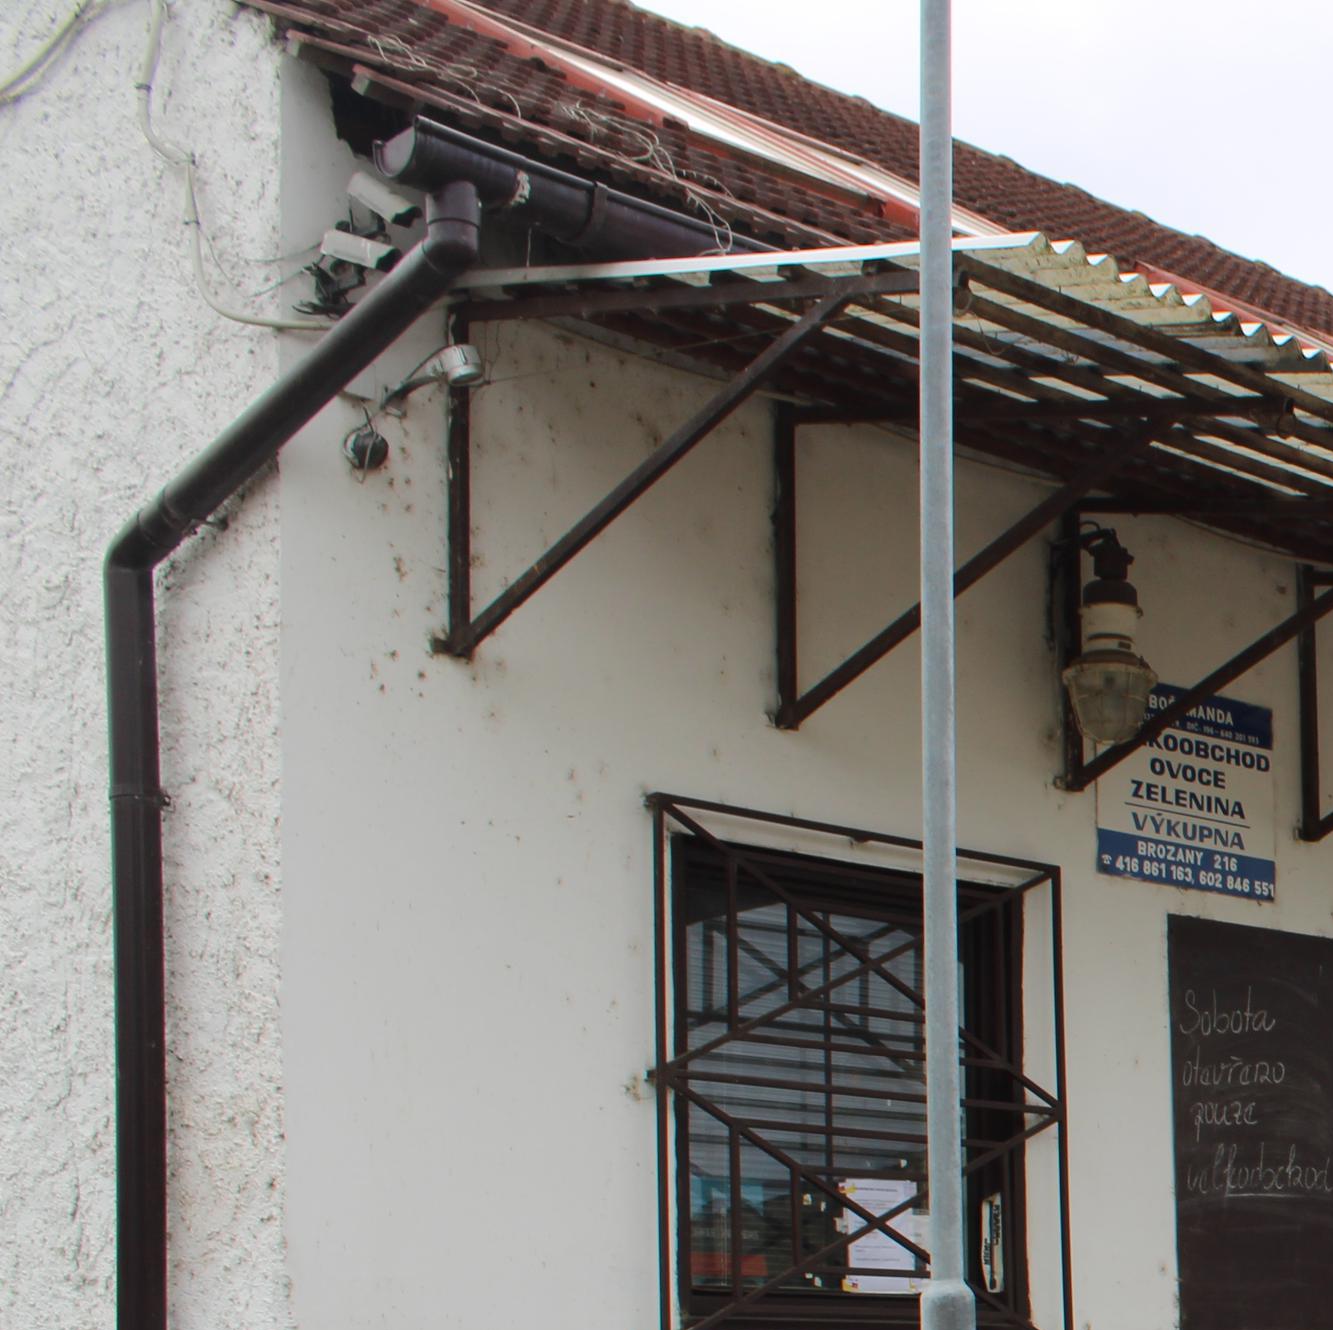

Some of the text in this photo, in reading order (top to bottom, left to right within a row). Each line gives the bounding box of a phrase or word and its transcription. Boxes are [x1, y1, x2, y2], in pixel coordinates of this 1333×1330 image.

[1148, 693, 1176, 710] BO
[1150, 757, 1226, 789] OVOCE
[1131, 779, 1245, 819] ZELENINA
[1132, 811, 1245, 850] VÝKUPNA
[1115, 855, 1274, 897] 416 861 163, 602 846 551
[1137, 840, 1238, 872] BROZANY 216
[1179, 985, 1276, 1036] Sobota
[1182, 1045, 1286, 1087] otevřeno
[1190, 1101, 1258, 1143] pouze
